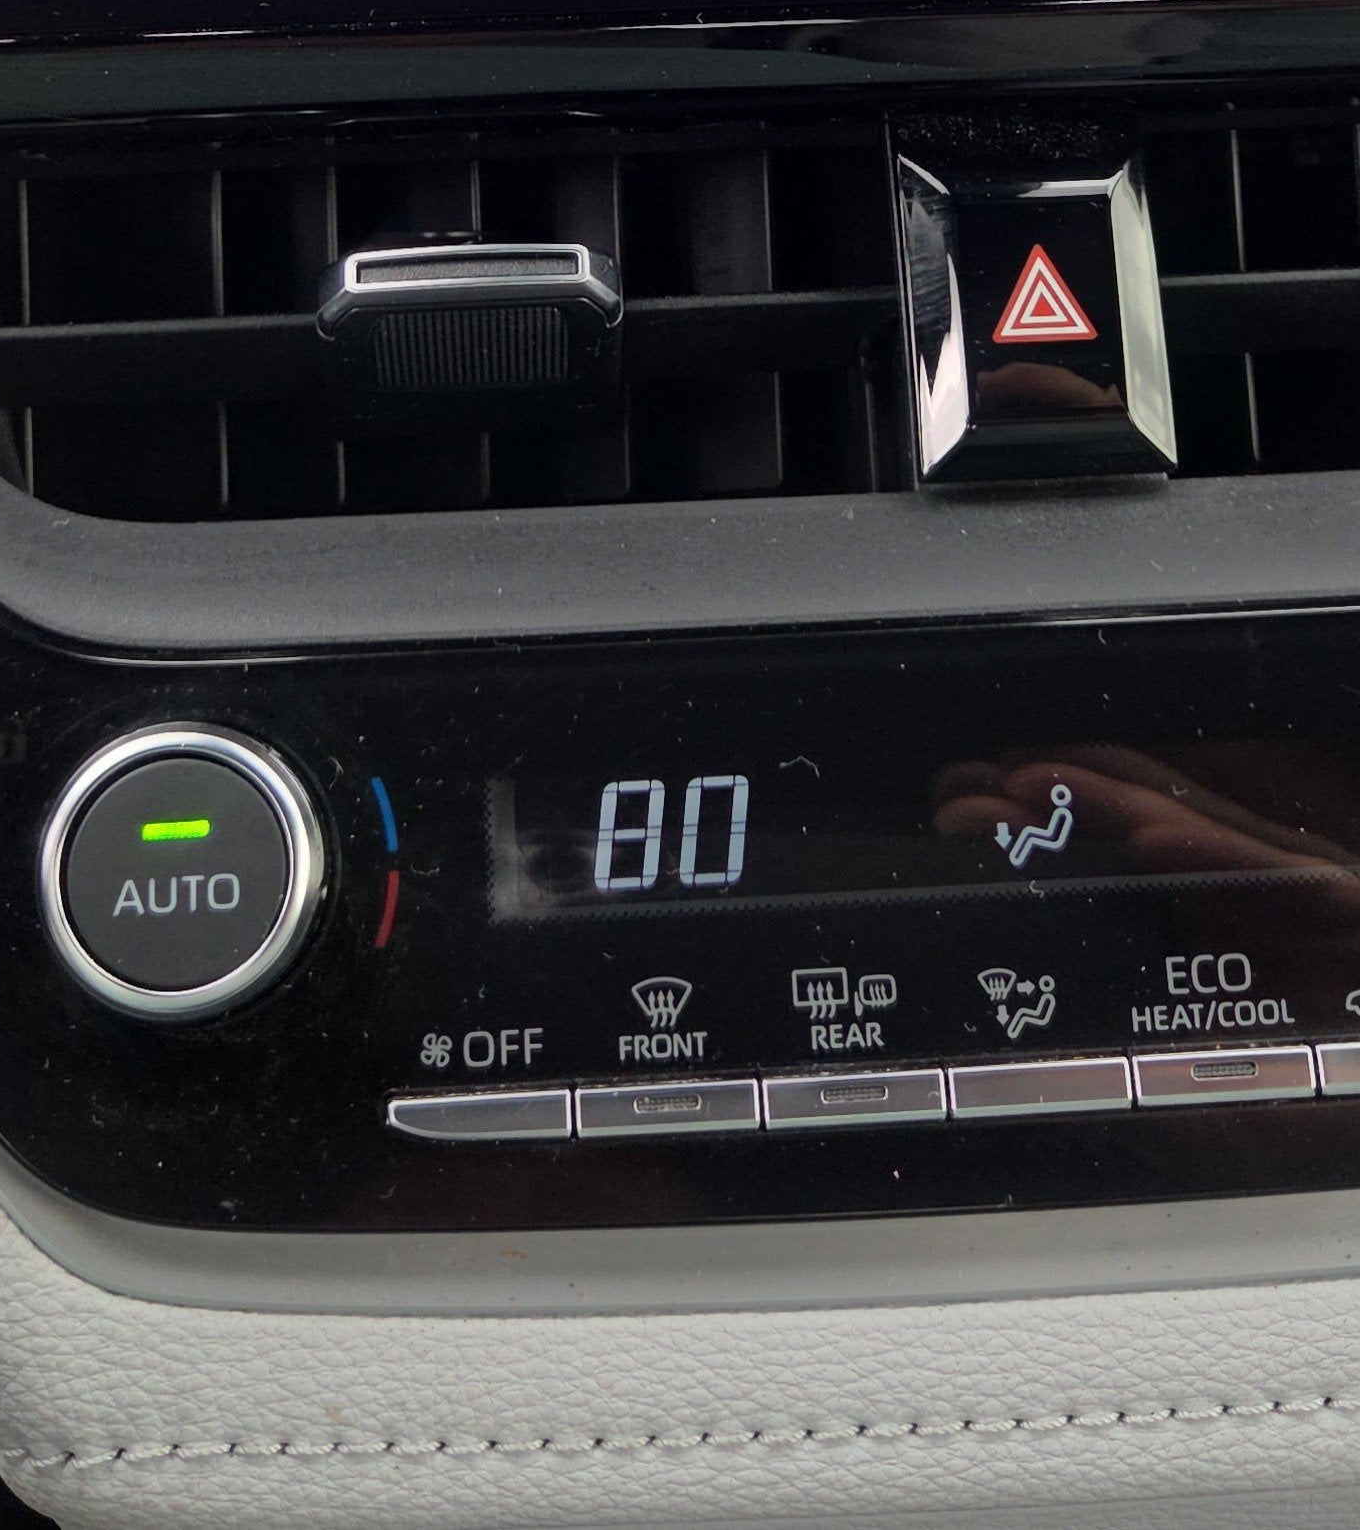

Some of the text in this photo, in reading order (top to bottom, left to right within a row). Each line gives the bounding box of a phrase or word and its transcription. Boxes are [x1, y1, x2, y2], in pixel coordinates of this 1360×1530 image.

[593, 774, 749, 891] 80
[113, 872, 240, 918] AUTO
[1166, 952, 1252, 996] ECO
[1131, 995, 1296, 1033] HEAT/COOL
[463, 1027, 544, 1069] OFF
[618, 1030, 708, 1062] FRONT
[811, 1022, 885, 1051] REAR
